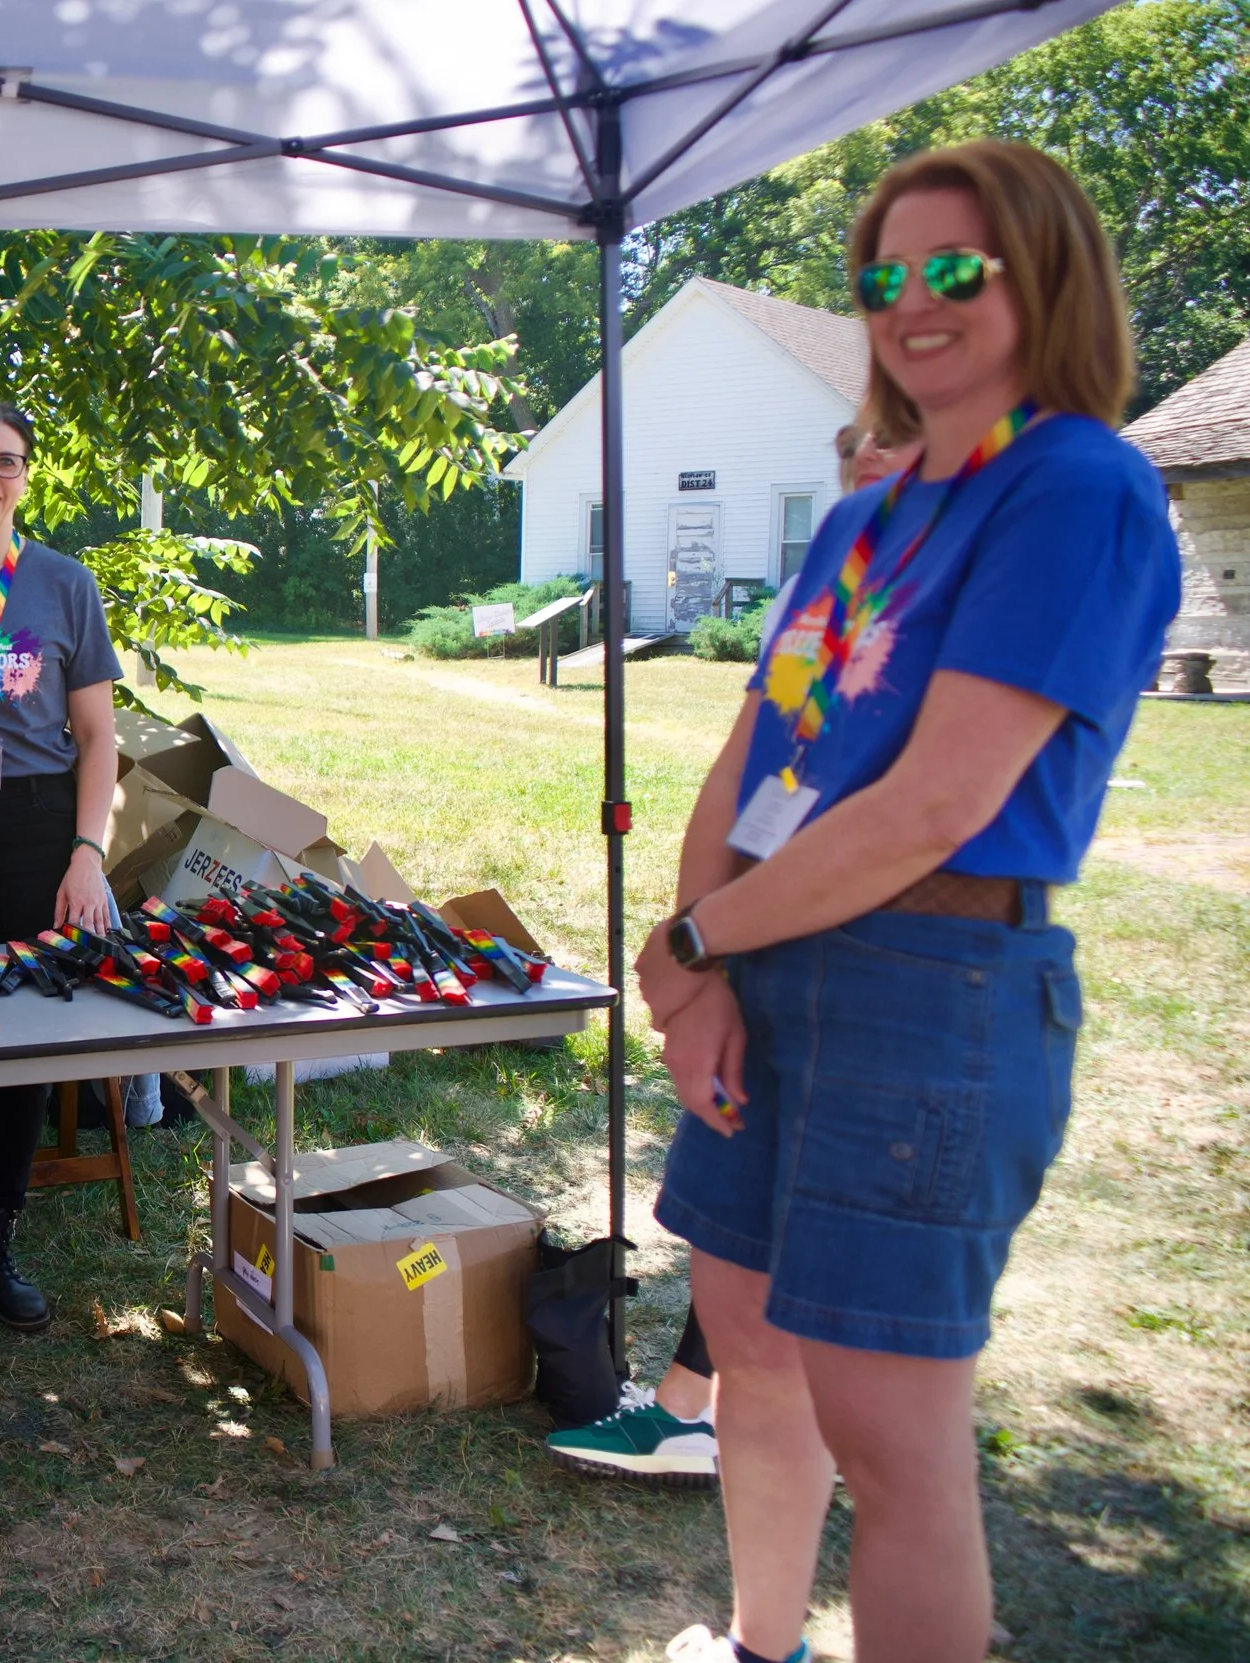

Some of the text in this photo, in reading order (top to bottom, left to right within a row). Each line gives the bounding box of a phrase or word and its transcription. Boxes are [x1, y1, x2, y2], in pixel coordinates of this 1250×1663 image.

[681, 479, 701, 488] DIST
[184, 849, 242, 892] JERZEES
[260, 1250, 272, 1275] HEA
[403, 1249, 442, 1283] HEAVY
